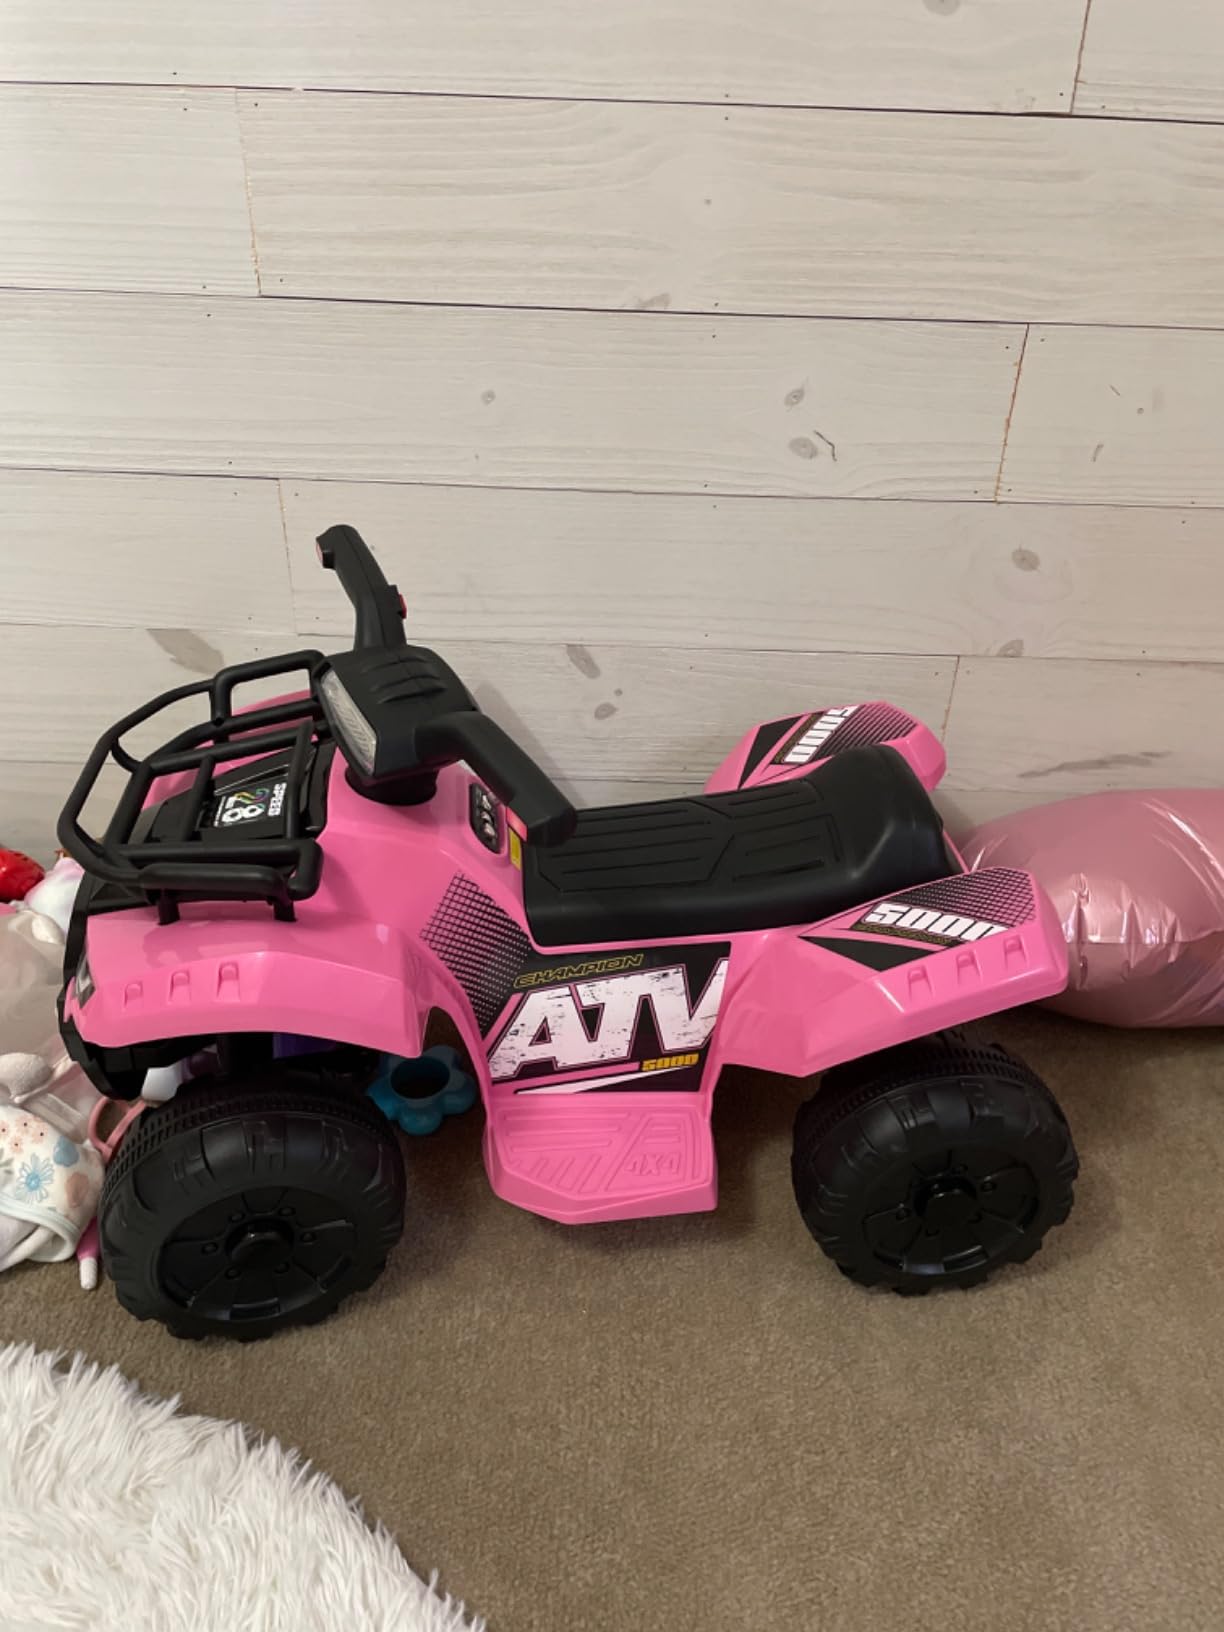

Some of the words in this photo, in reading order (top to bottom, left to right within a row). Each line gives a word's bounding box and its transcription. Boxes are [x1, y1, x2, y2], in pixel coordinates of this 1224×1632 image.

[513, 954, 644, 988] CHAMPION
[488, 959, 729, 1081] ATV
[641, 1053, 699, 1072] 5000
